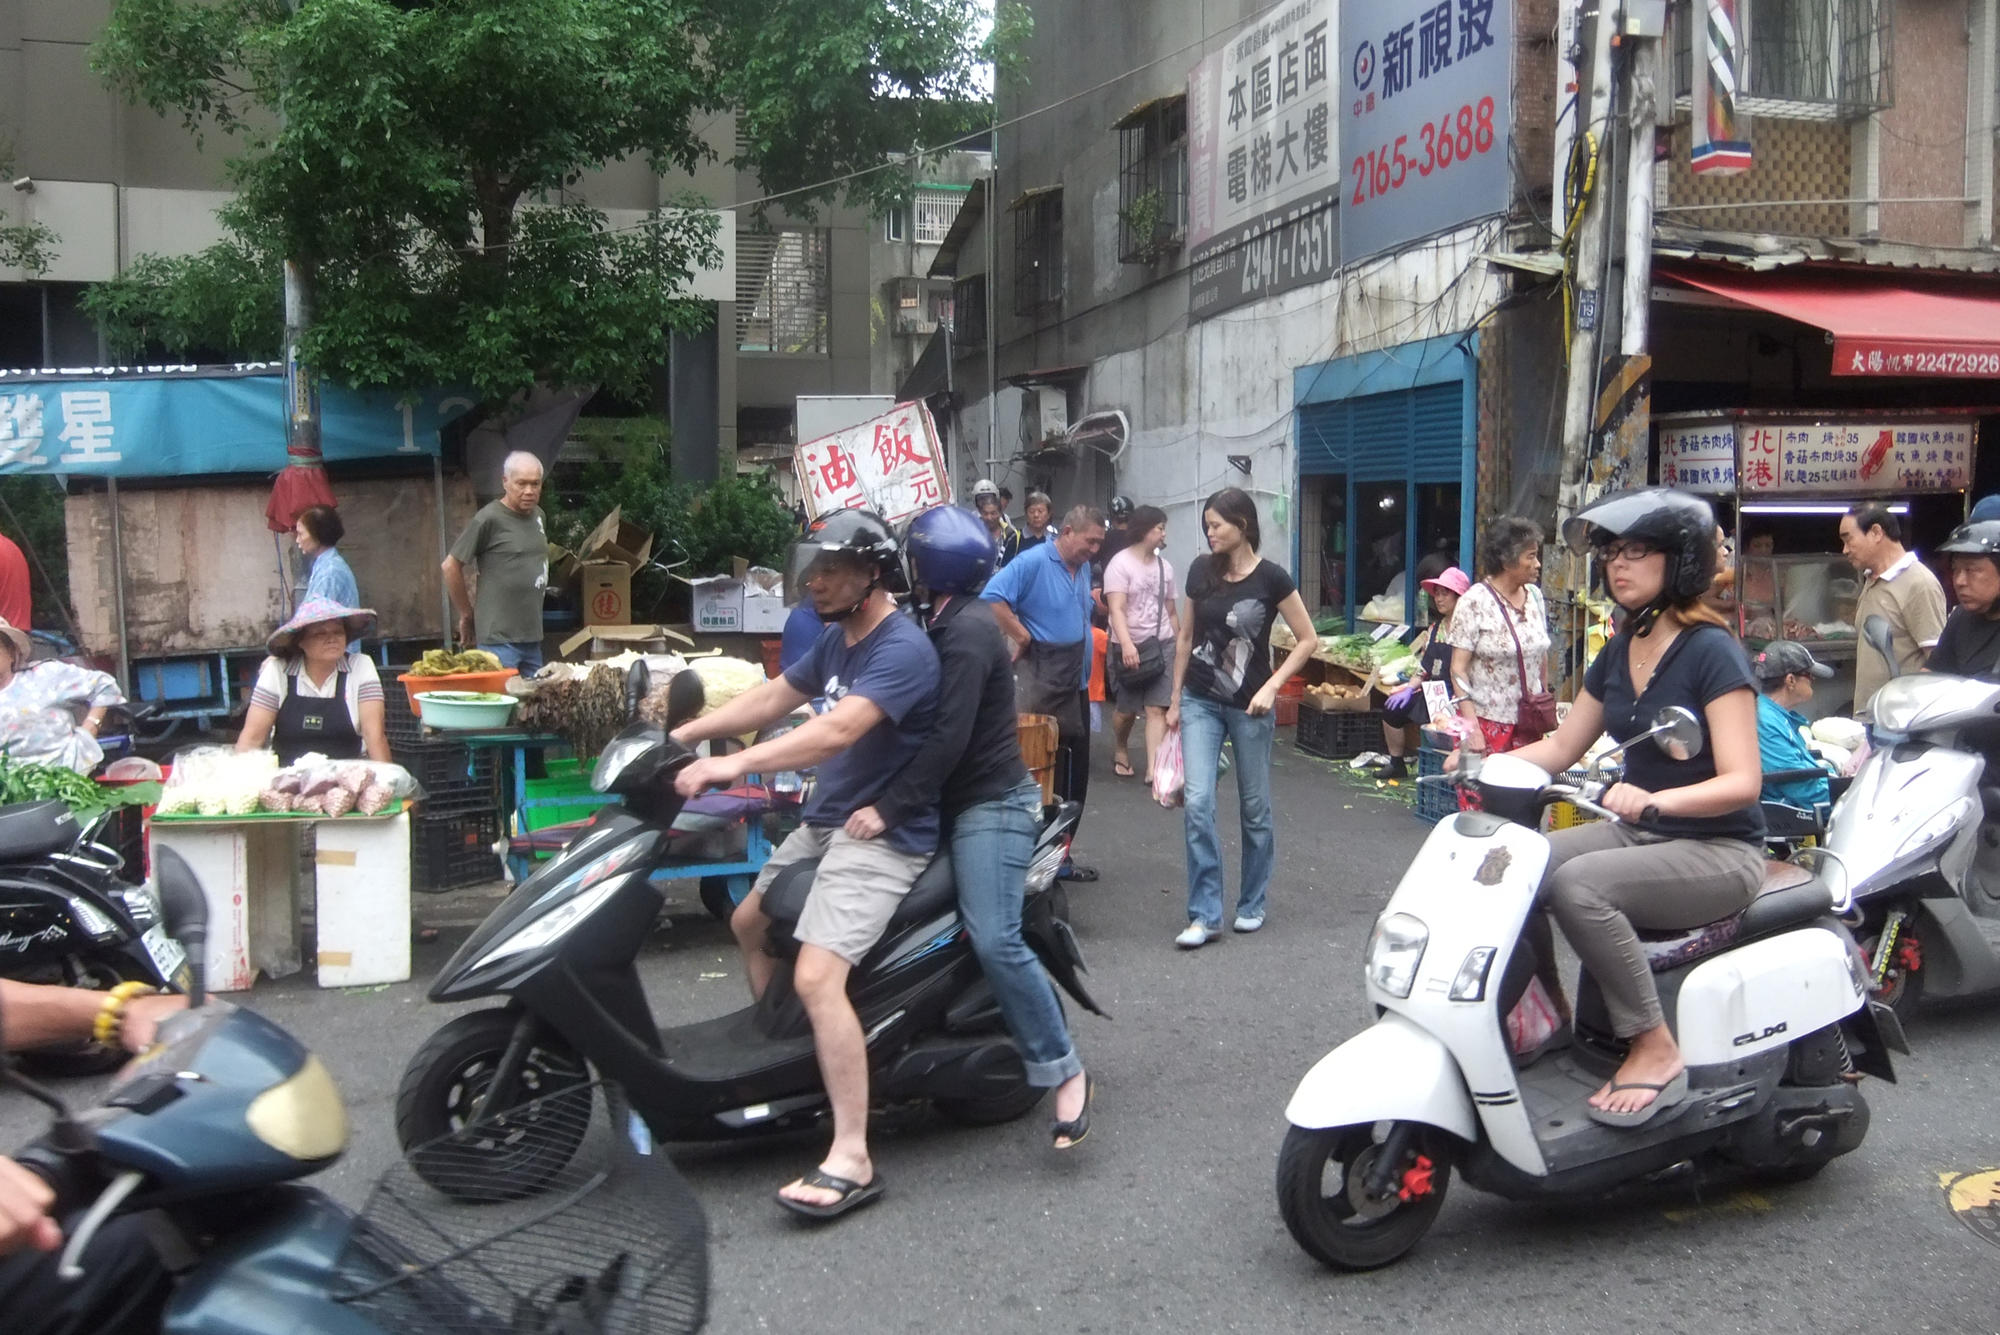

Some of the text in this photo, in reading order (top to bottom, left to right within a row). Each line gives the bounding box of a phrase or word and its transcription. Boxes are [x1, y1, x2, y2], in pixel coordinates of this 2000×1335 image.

[1227, 19, 1329, 131] 本區店面
[1382, 0, 1495, 100] 新視波
[1227, 101, 1329, 204] 電梯大樓
[1351, 95, 1495, 207] 2165-3688
[1242, 195, 1332, 294] 2947-7551
[1916, 352, 2000, 373] 22472926
[807, 417, 932, 499] 油飯
[1664, 434, 1677, 488] 北港
[1747, 429, 1775, 487] 北港
[1845, 451, 1858, 462] 35
[1847, 432, 1859, 444] 35
[911, 470, 938, 504] 元
[1808, 472, 1820, 483] 25
